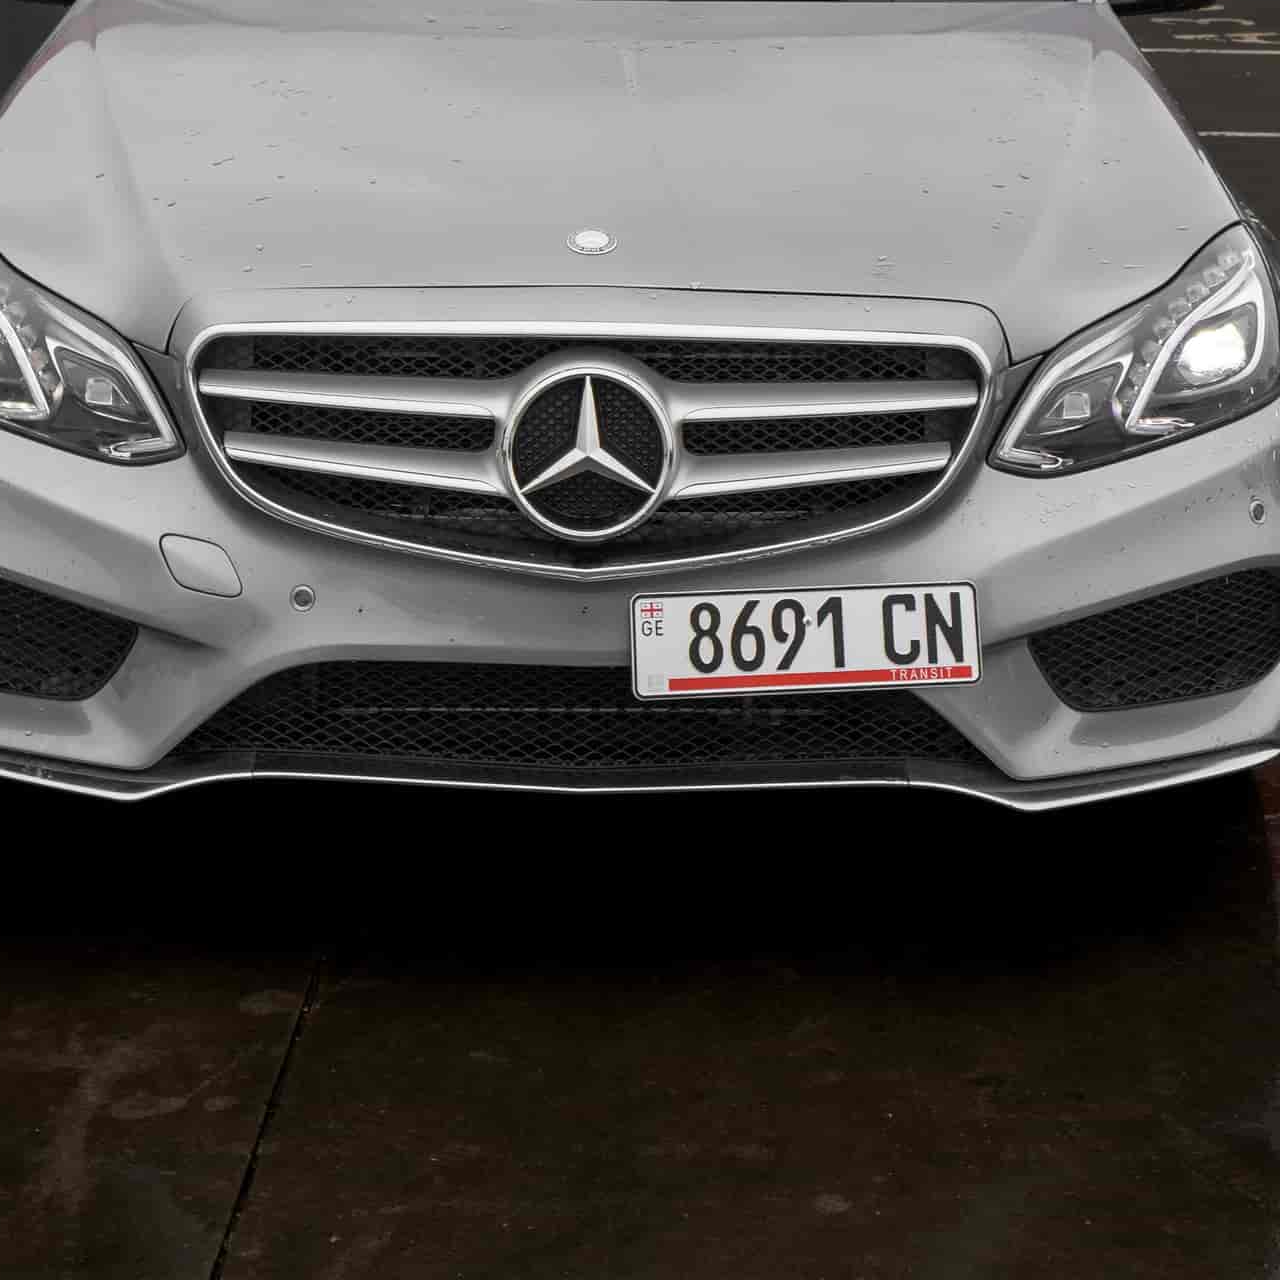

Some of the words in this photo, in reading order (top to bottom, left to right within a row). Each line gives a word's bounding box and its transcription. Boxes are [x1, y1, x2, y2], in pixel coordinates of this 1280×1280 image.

[641, 620, 664, 637] GE
[688, 596, 845, 673] 8691
[882, 591, 965, 665] CN
[889, 666, 954, 681] TRANSIT
